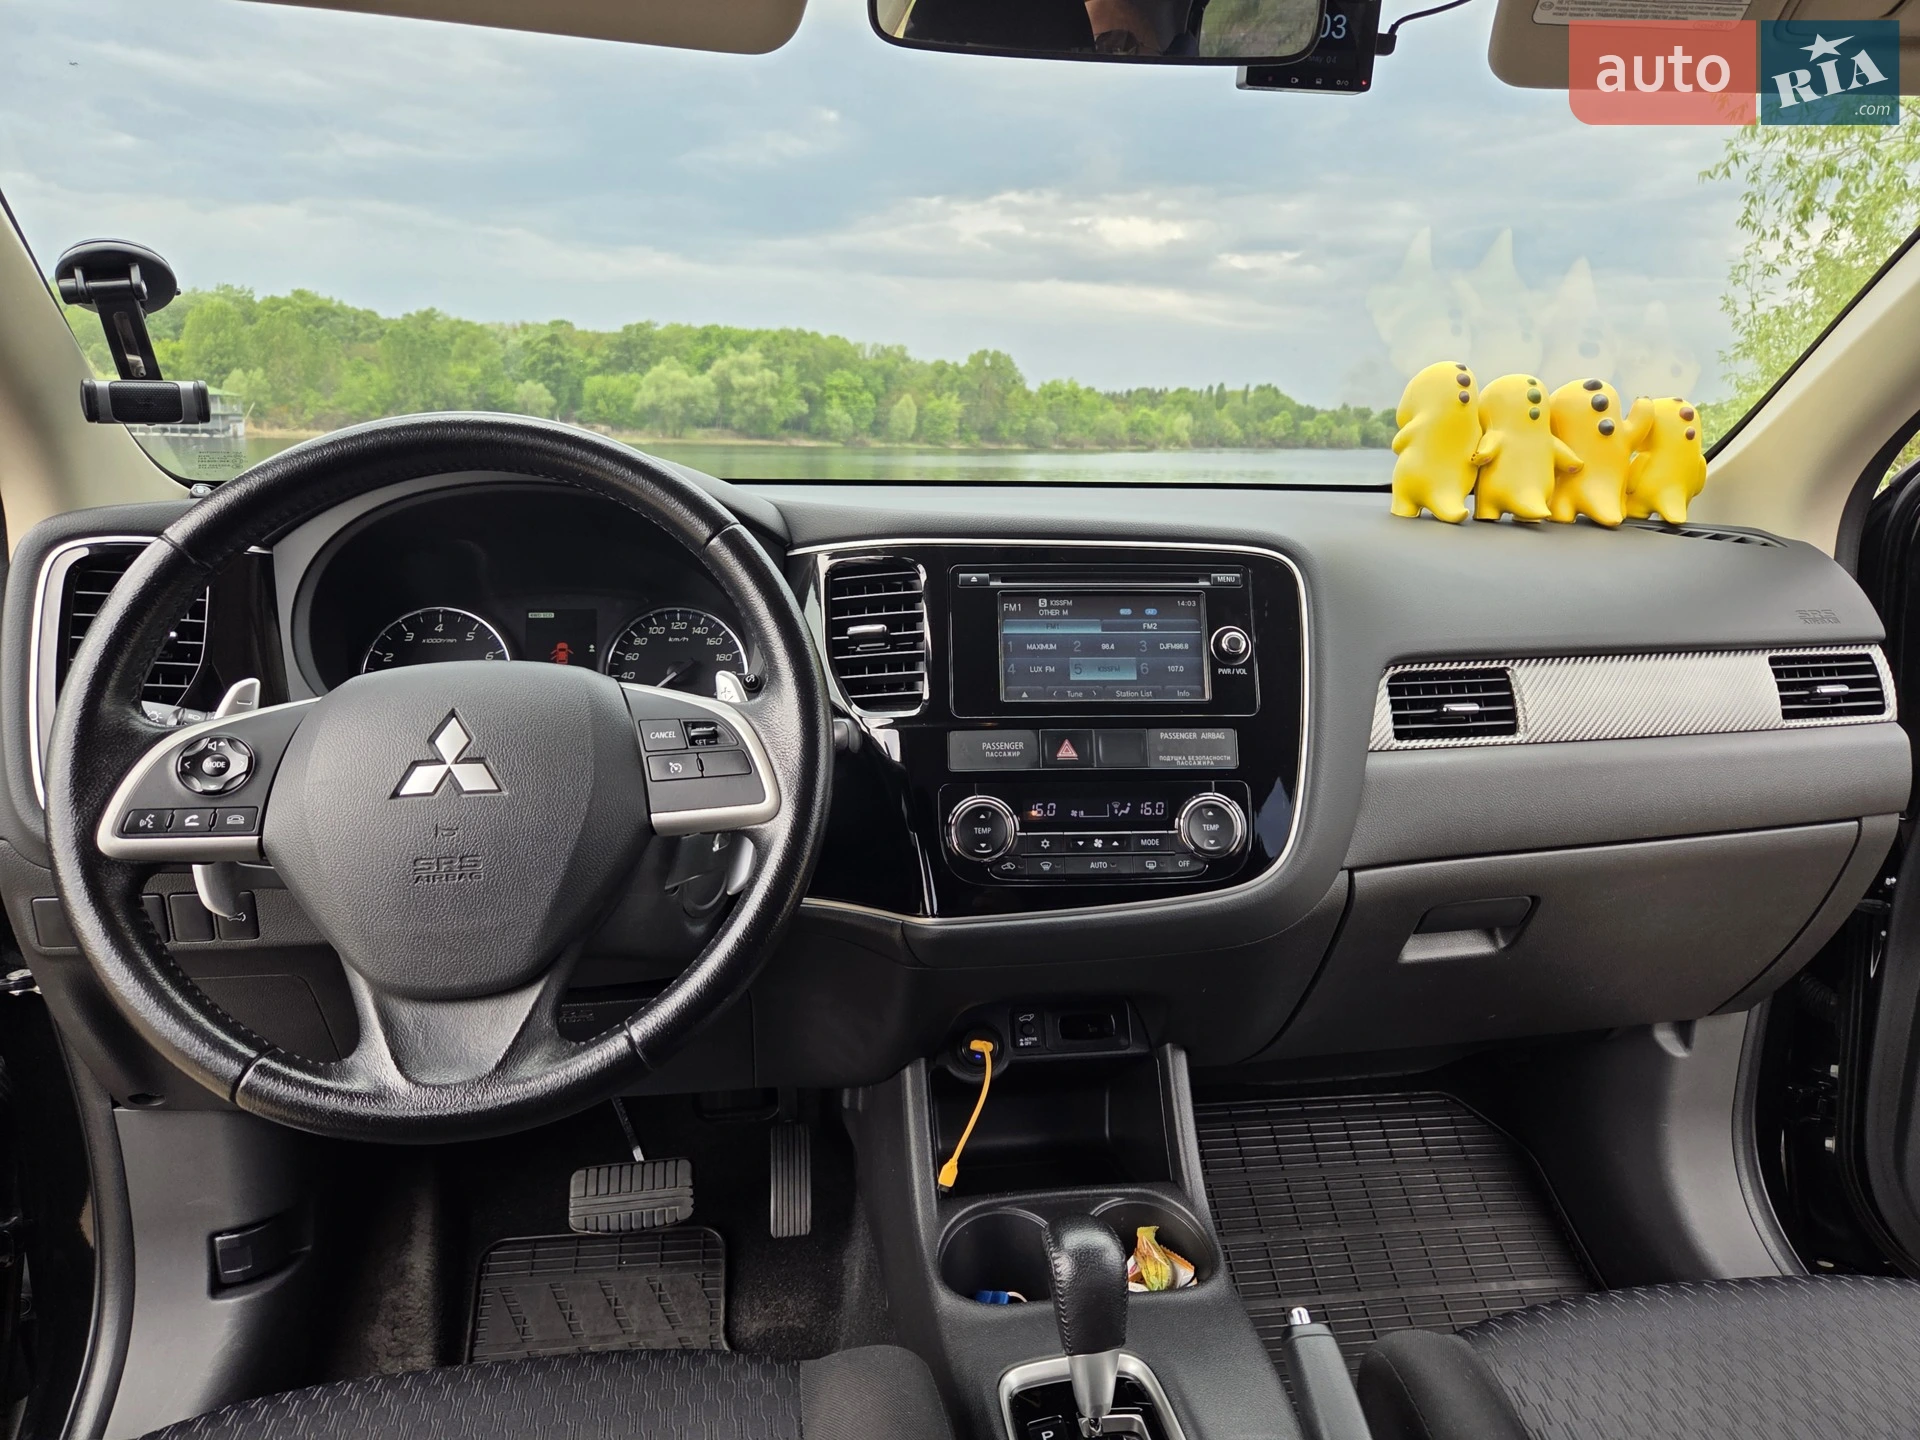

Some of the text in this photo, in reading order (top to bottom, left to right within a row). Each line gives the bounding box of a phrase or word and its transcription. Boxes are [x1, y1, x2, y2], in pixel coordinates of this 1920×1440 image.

[1003, 603, 1022, 612] FM1
[434, 623, 444, 633] 4
[648, 626, 665, 634] 100
[671, 621, 688, 630] 120
[692, 626, 709, 634] 140
[404, 632, 415, 642] 3
[465, 631, 476, 641] 5
[633, 637, 648, 646] 80
[706, 637, 723, 646] 160
[1073, 640, 1081, 652] 2
[1139, 640, 1148, 652] 3
[1007, 640, 1014, 653] 1
[383, 652, 394, 662] 2
[484, 651, 495, 661] 6
[625, 653, 640, 661] 60
[716, 653, 733, 661] 180
[1007, 663, 1016, 675] 4
[1074, 663, 1082, 675] 5
[1140, 662, 1184, 675] 6 107.0
[620, 672, 636, 680] 40
[1067, 690, 1083, 698] Tune
[1115, 690, 1153, 698] Station List
[650, 731, 677, 740] CANCEL
[1160, 732, 1225, 740] PASSENGER AIRBAG
[982, 741, 1025, 750] PASSENGER
[1140, 801, 1165, 815] 16.0
[413, 855, 483, 873] SRS
[1090, 861, 1108, 869] AUTO
[1178, 860, 1191, 868] OFF
[1041, 1430, 1054, 1440] P
